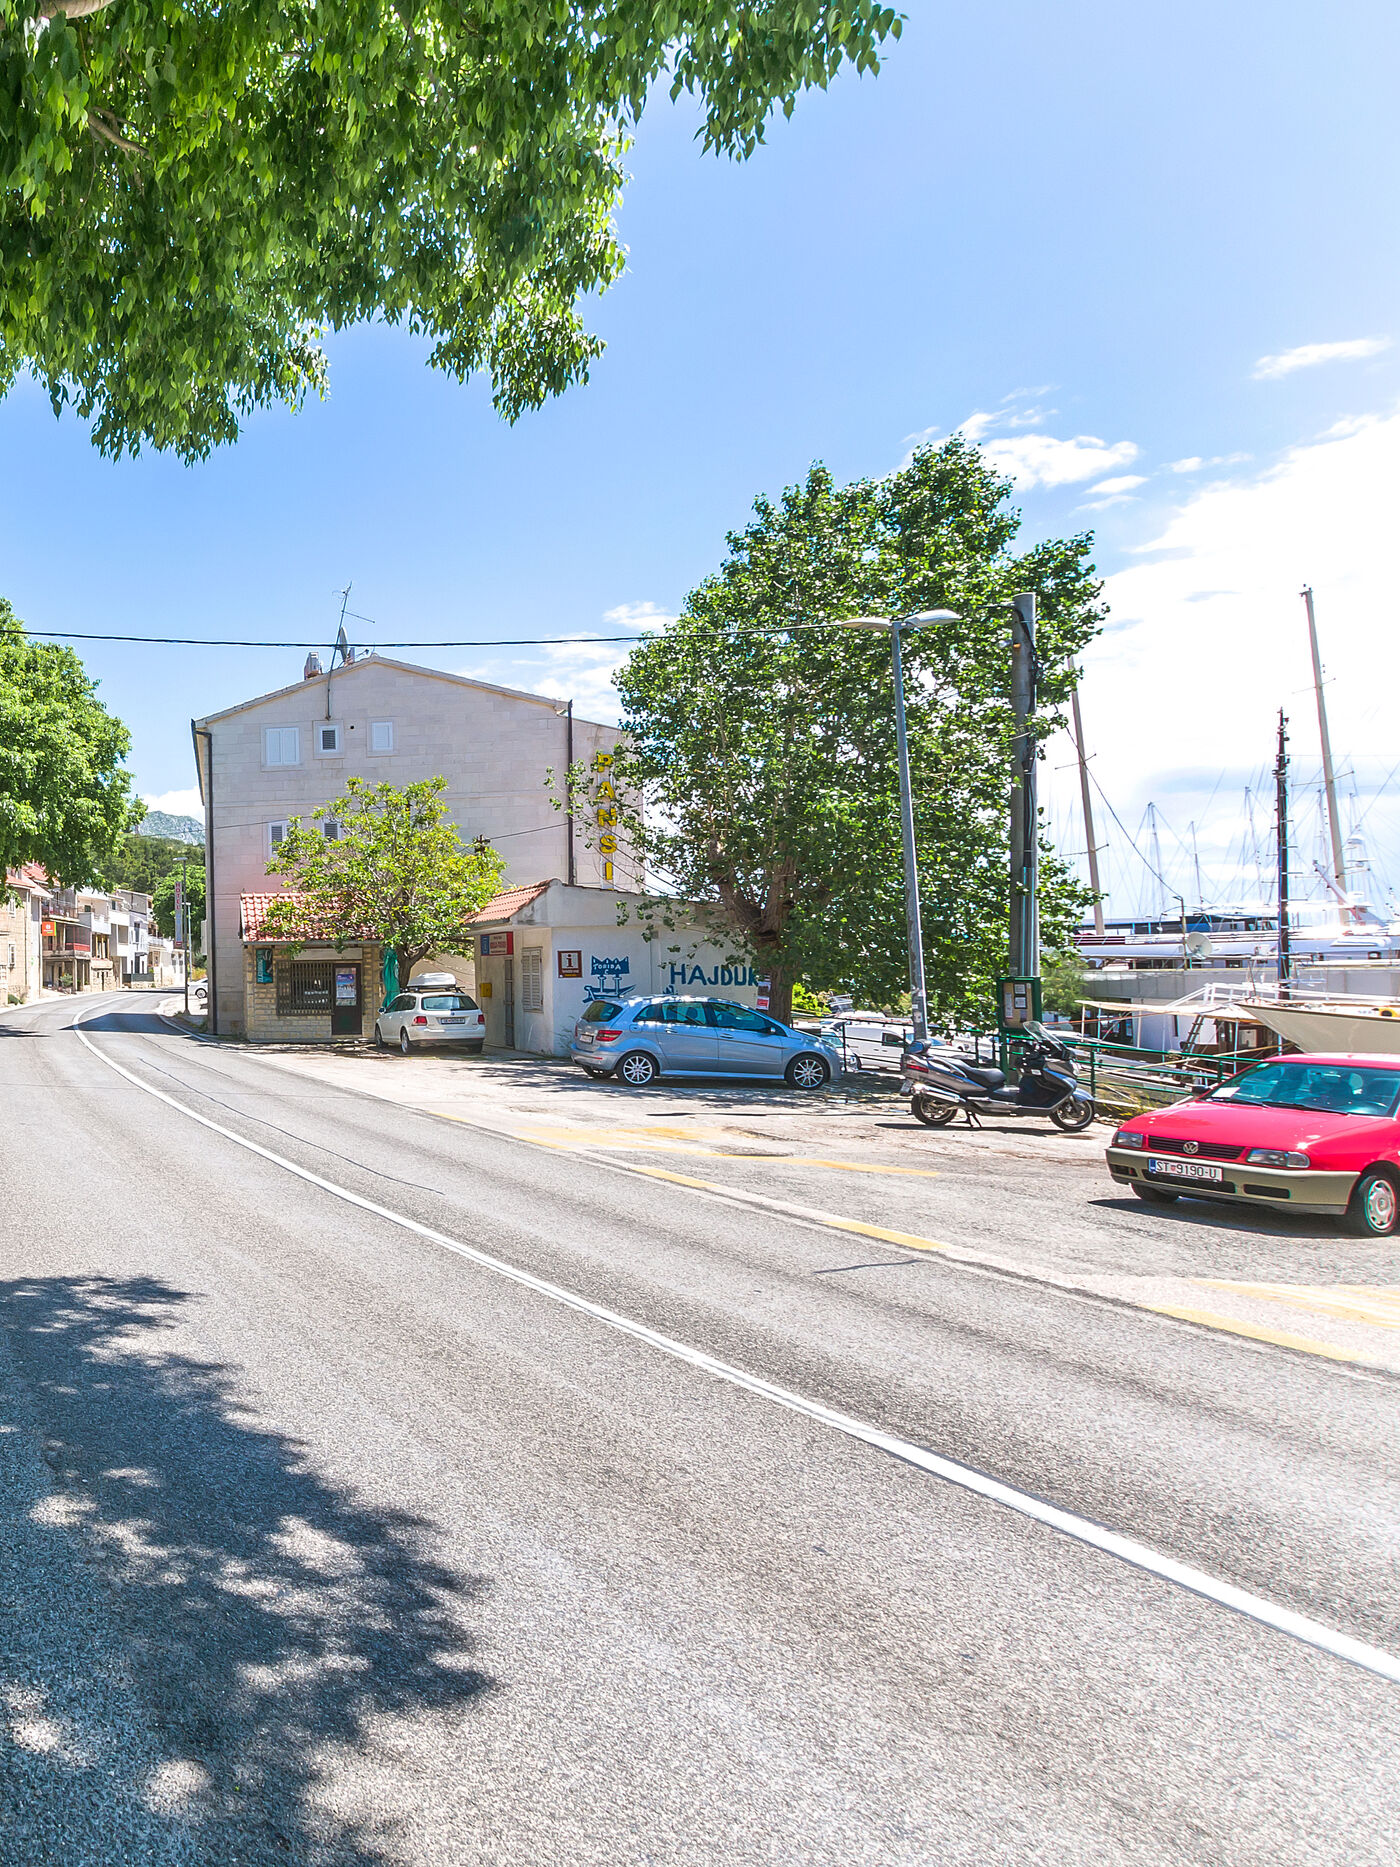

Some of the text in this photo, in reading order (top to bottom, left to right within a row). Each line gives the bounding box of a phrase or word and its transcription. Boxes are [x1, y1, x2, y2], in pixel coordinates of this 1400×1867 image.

[597, 754, 617, 890] PANSI
[670, 964, 759, 986] HAJDUK
[1156, 1161, 1217, 1179] ST 9190-U
